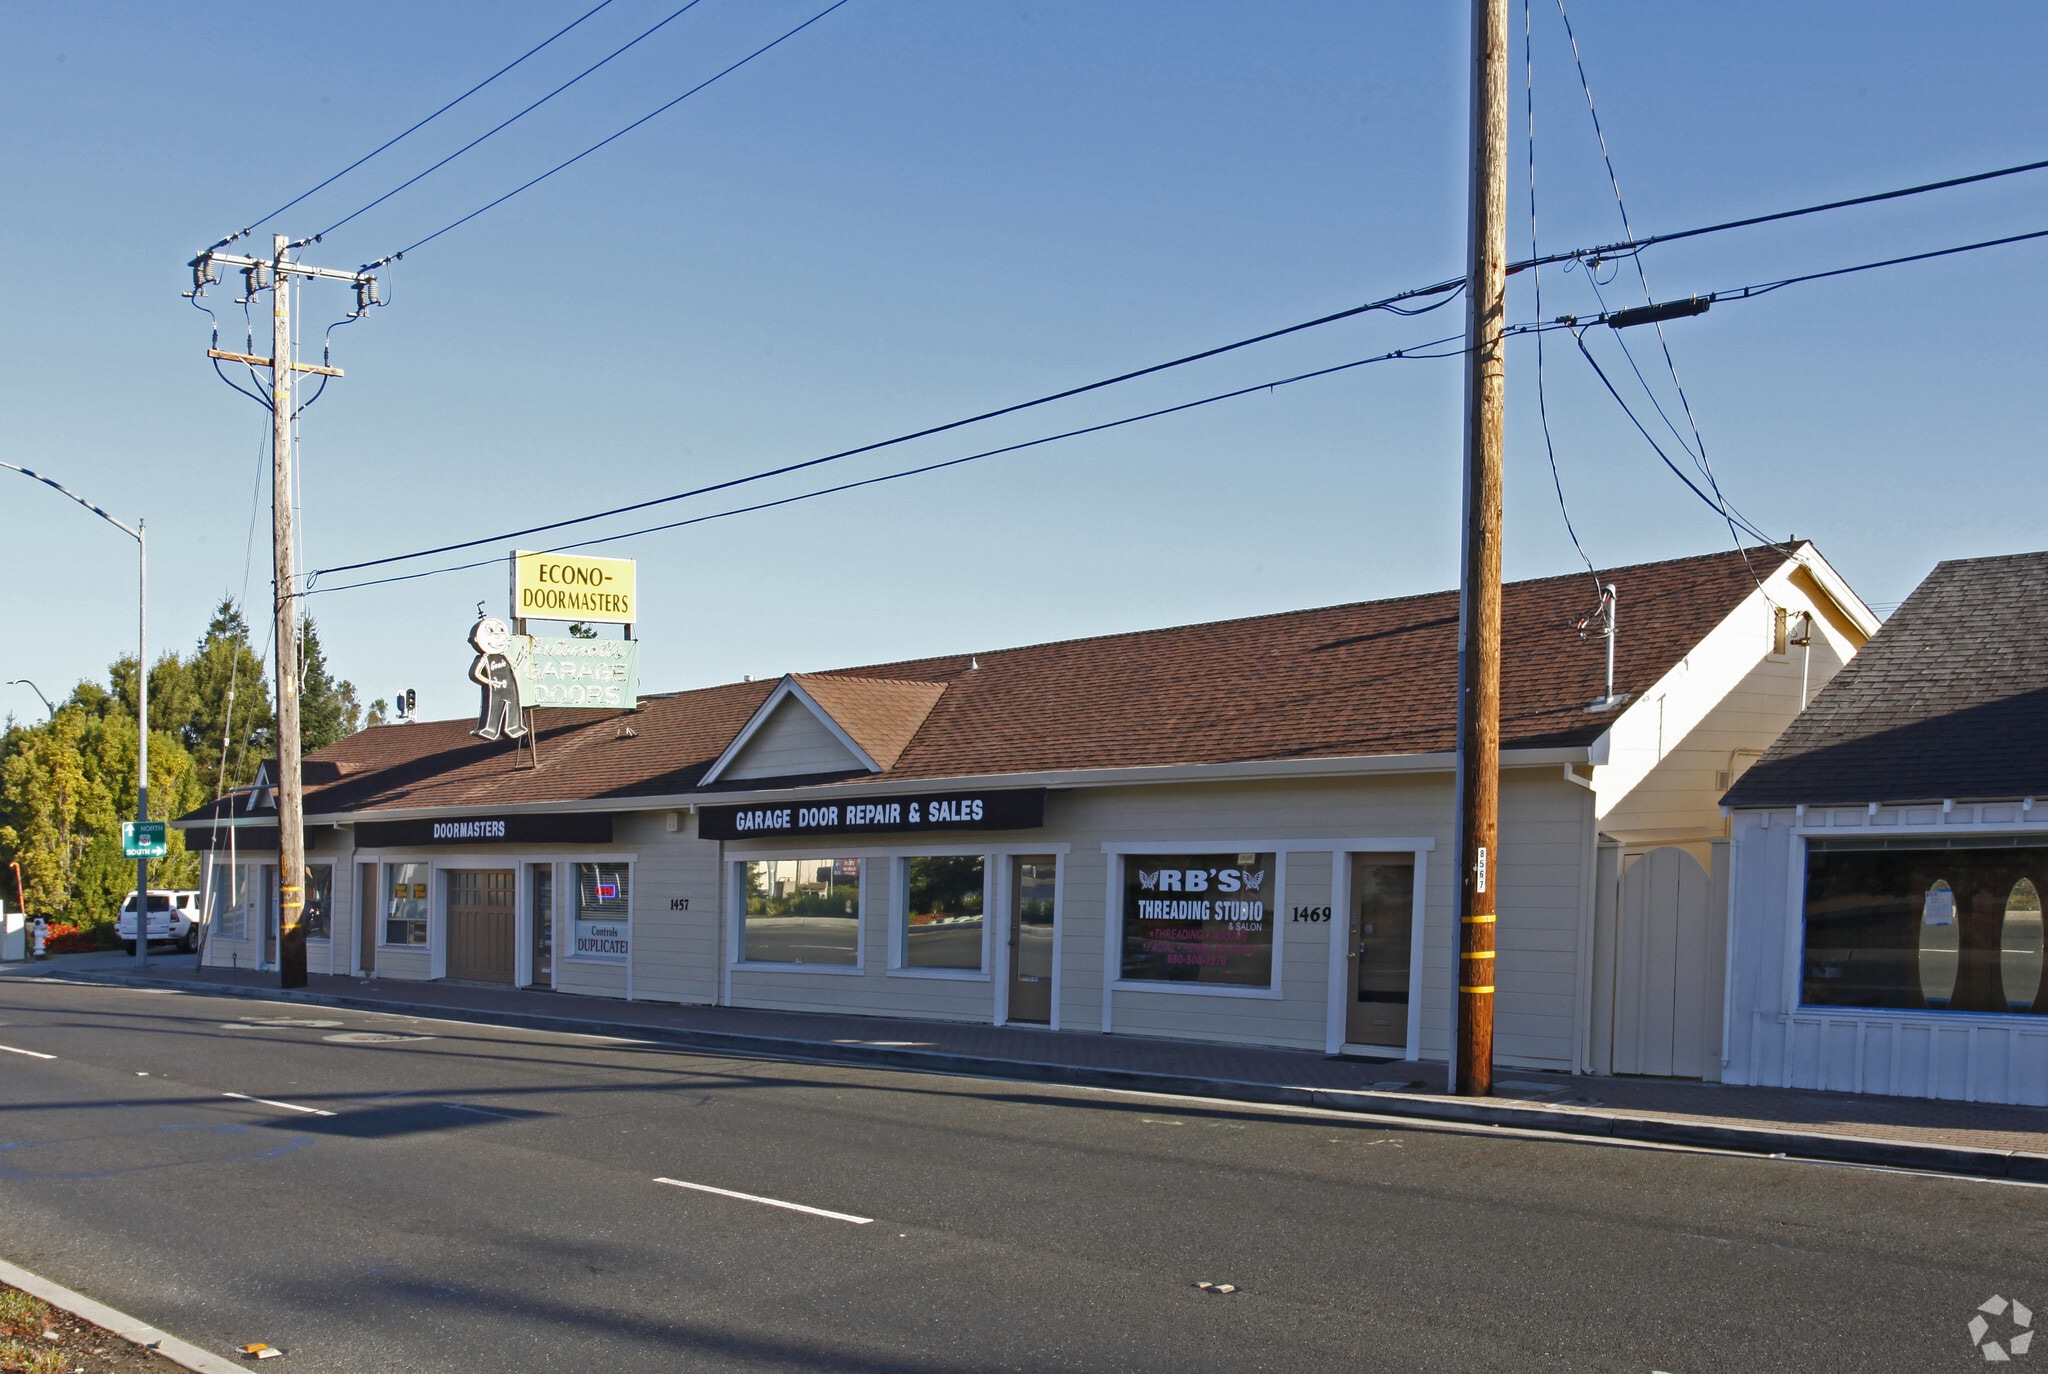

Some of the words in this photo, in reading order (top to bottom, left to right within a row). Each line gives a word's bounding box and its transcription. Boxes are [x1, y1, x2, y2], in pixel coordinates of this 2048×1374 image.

[539, 564, 613, 587] ECONO-
[523, 588, 629, 613] DOORMASTERS
[524, 661, 627, 682] GARAGE
[534, 684, 621, 705] DOORS
[736, 809, 792, 831] GARAGE
[798, 803, 839, 828] DOOR
[846, 803, 901, 825] REPAIR
[908, 802, 920, 823] &
[928, 799, 983, 822] SALES
[433, 821, 506, 838] DOORMASTERS
[125, 848, 150, 856] SOUTH
[1159, 868, 1241, 892] RB'S
[670, 899, 689, 911] 1457
[1138, 900, 1210, 920] THREADING
[1214, 901, 1263, 921] STUDIO
[1292, 906, 1332, 922] 1469
[591, 925, 618, 937] Controls
[1155, 928, 1203, 940] THREADING
[1228, 922, 1235, 931] &
[1235, 922, 1262, 932] SALON
